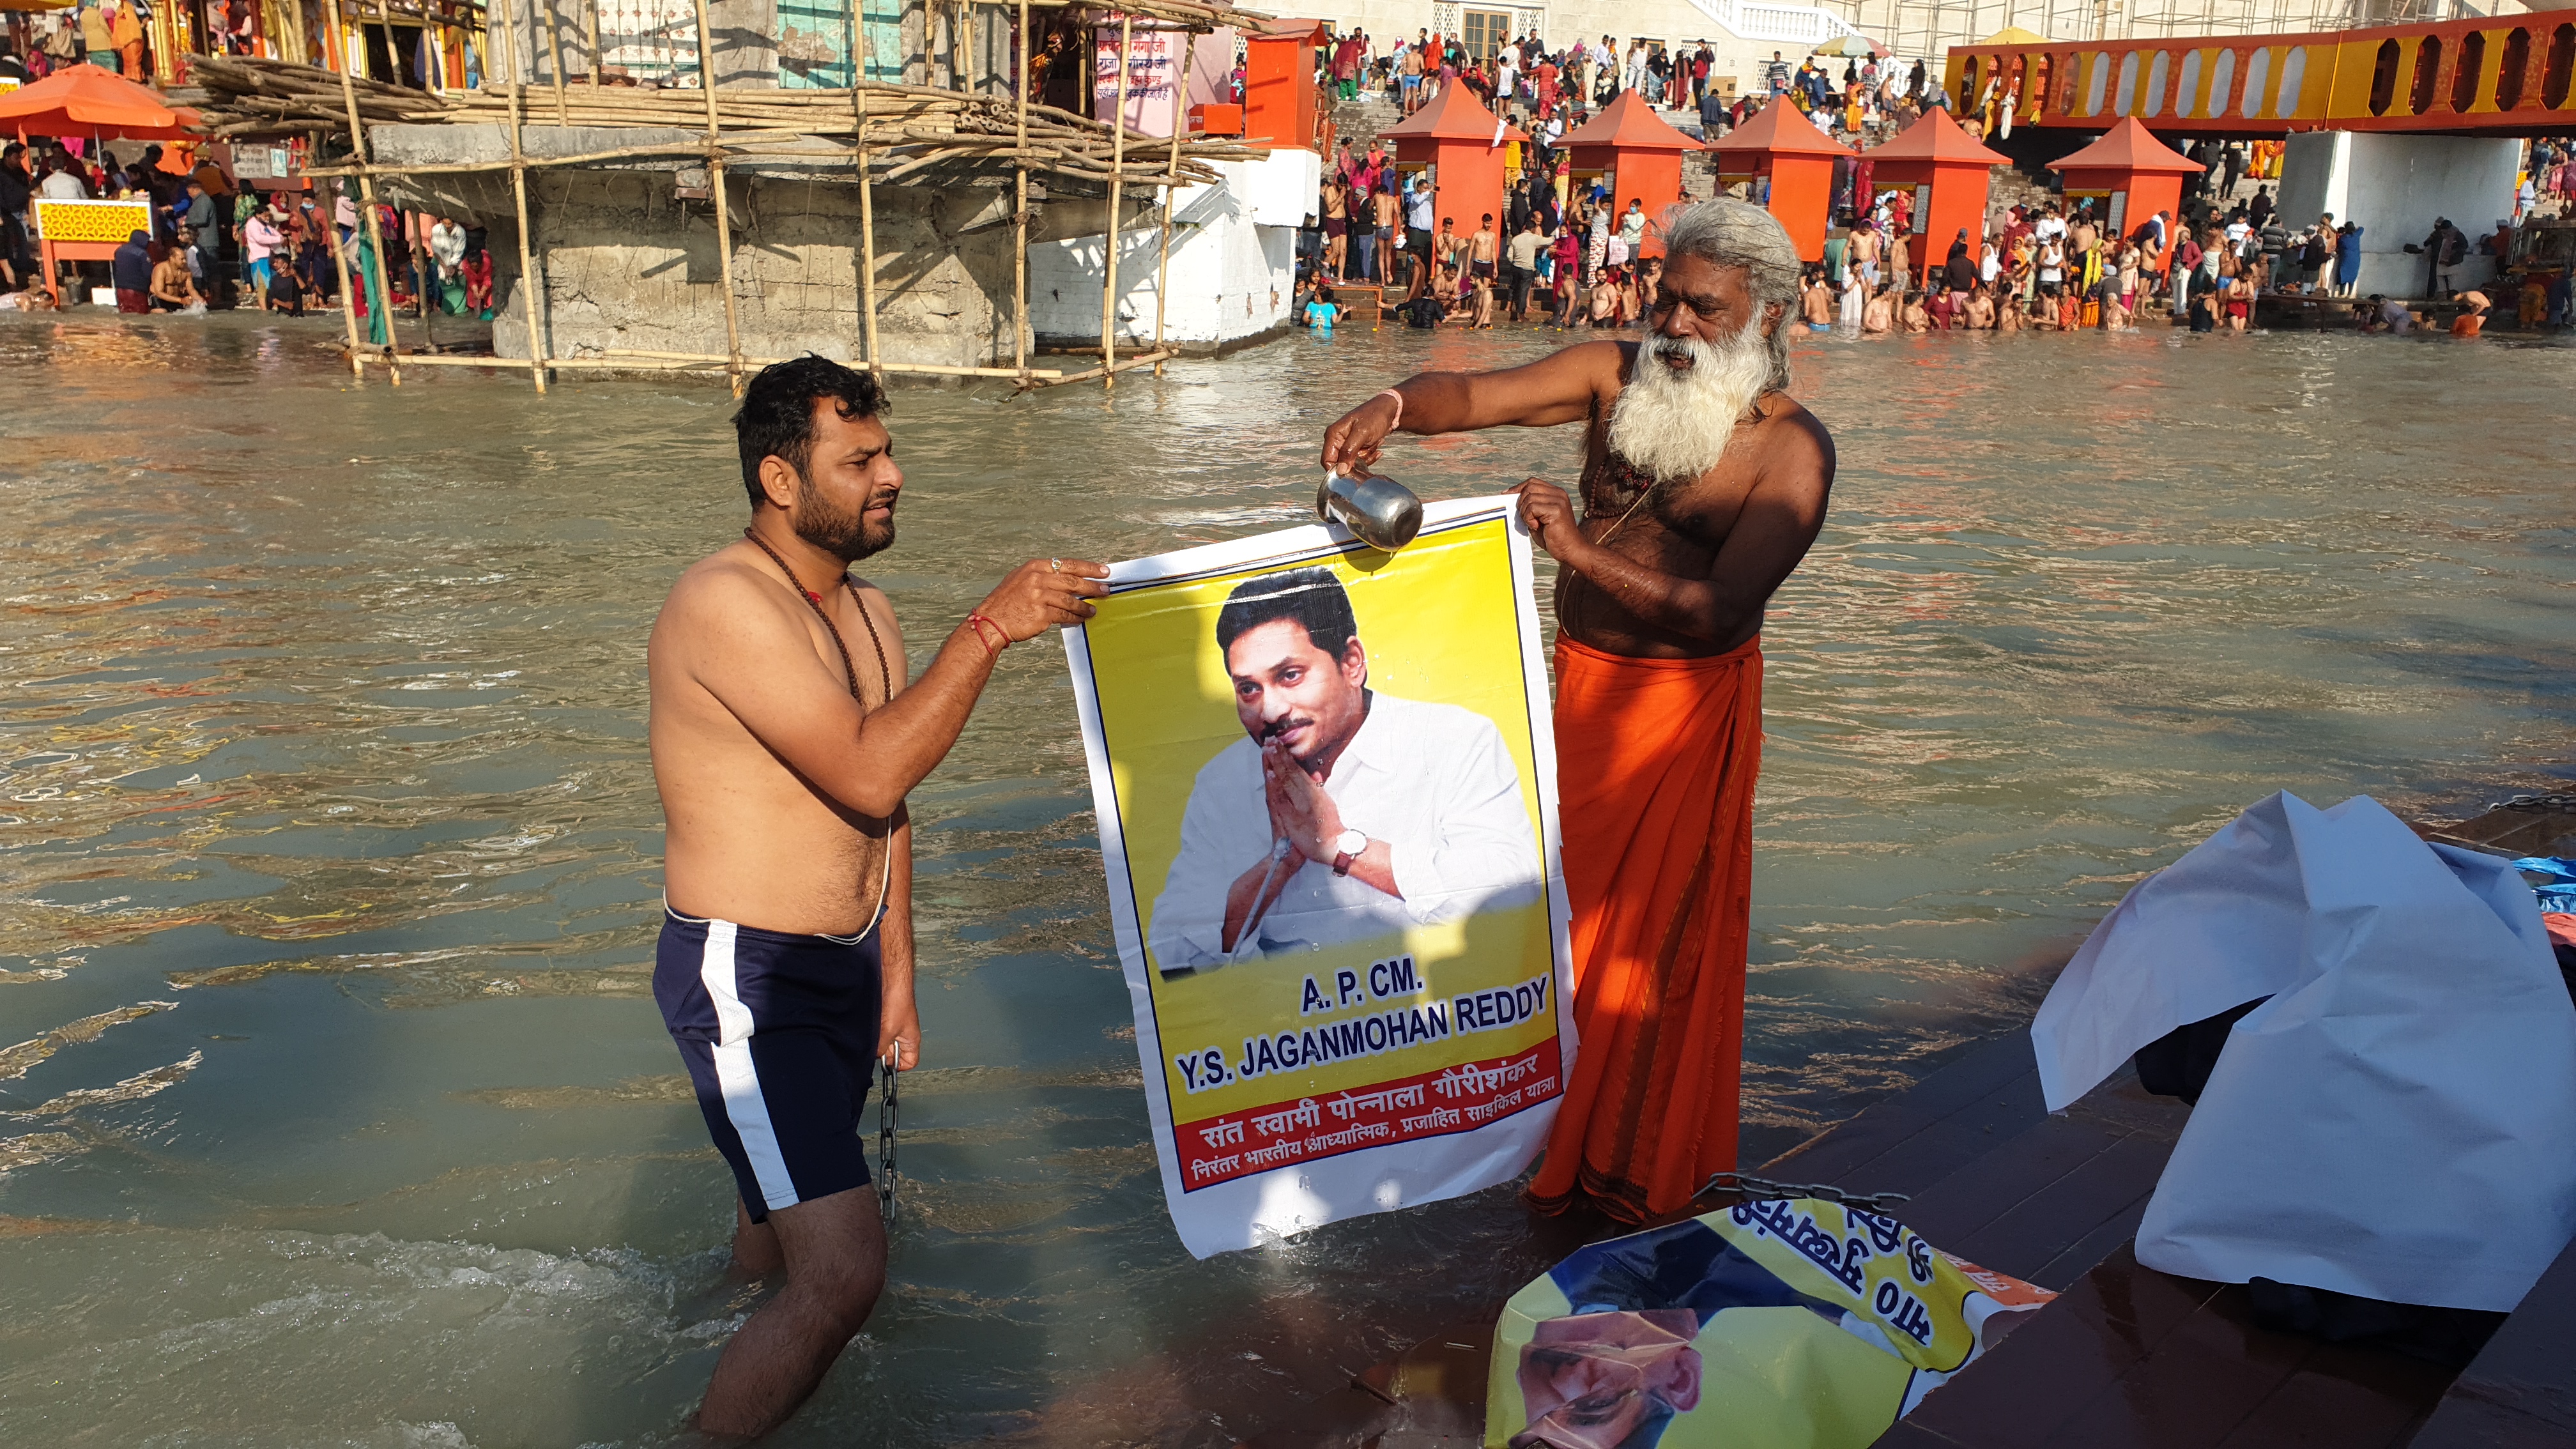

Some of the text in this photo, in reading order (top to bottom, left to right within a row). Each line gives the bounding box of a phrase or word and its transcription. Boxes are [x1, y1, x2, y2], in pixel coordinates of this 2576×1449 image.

[1098, 56, 1167, 70] राजा गीरथ जी
[1153, 38, 1166, 53] जी
[1144, 75, 1162, 87] कुण्ड
[1303, 958, 1423, 1012] A. P. CM.
[1177, 976, 1547, 1089] Y.S. JAGANMOHAN REDDY
[1191, 1154, 1240, 1181] निरंतर
[1245, 1138, 1302, 1165] भारतीय
[1400, 1107, 1460, 1133] प्रजाहित
[1464, 1089, 1521, 1122] साइकिल
[1525, 1075, 1555, 1098] यात्रा
[1199, 1054, 1538, 1149] संत स्वामी पोन्नाला गौरीशंकर
